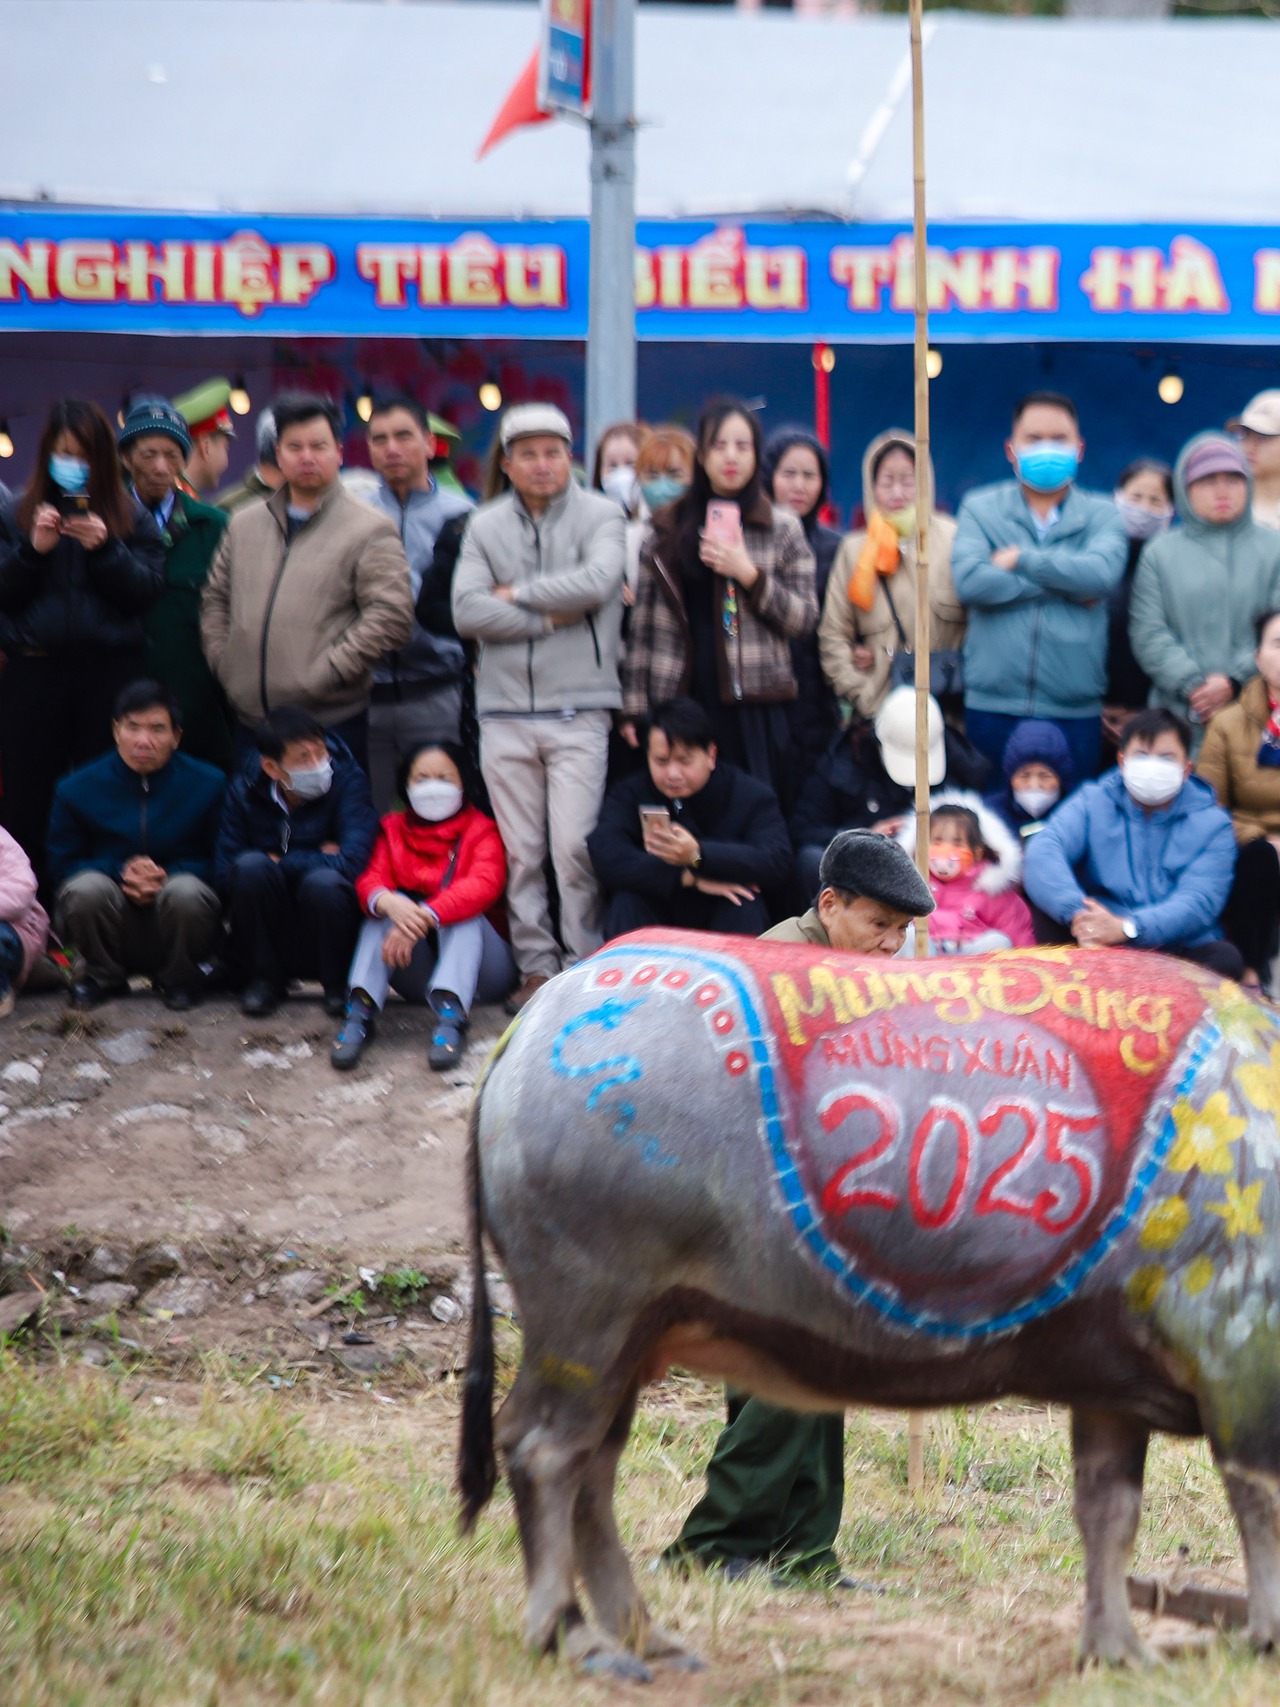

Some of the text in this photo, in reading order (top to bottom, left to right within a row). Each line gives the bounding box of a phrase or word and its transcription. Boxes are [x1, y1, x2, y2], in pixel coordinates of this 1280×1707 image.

[0, 230, 335, 319] NGHIỆP
[357, 232, 568, 310] TIÊU
[1081, 235, 1230, 314] HÀ
[957, 1032, 1076, 1092] XUÂN
[818, 1083, 1102, 1236] 2025
